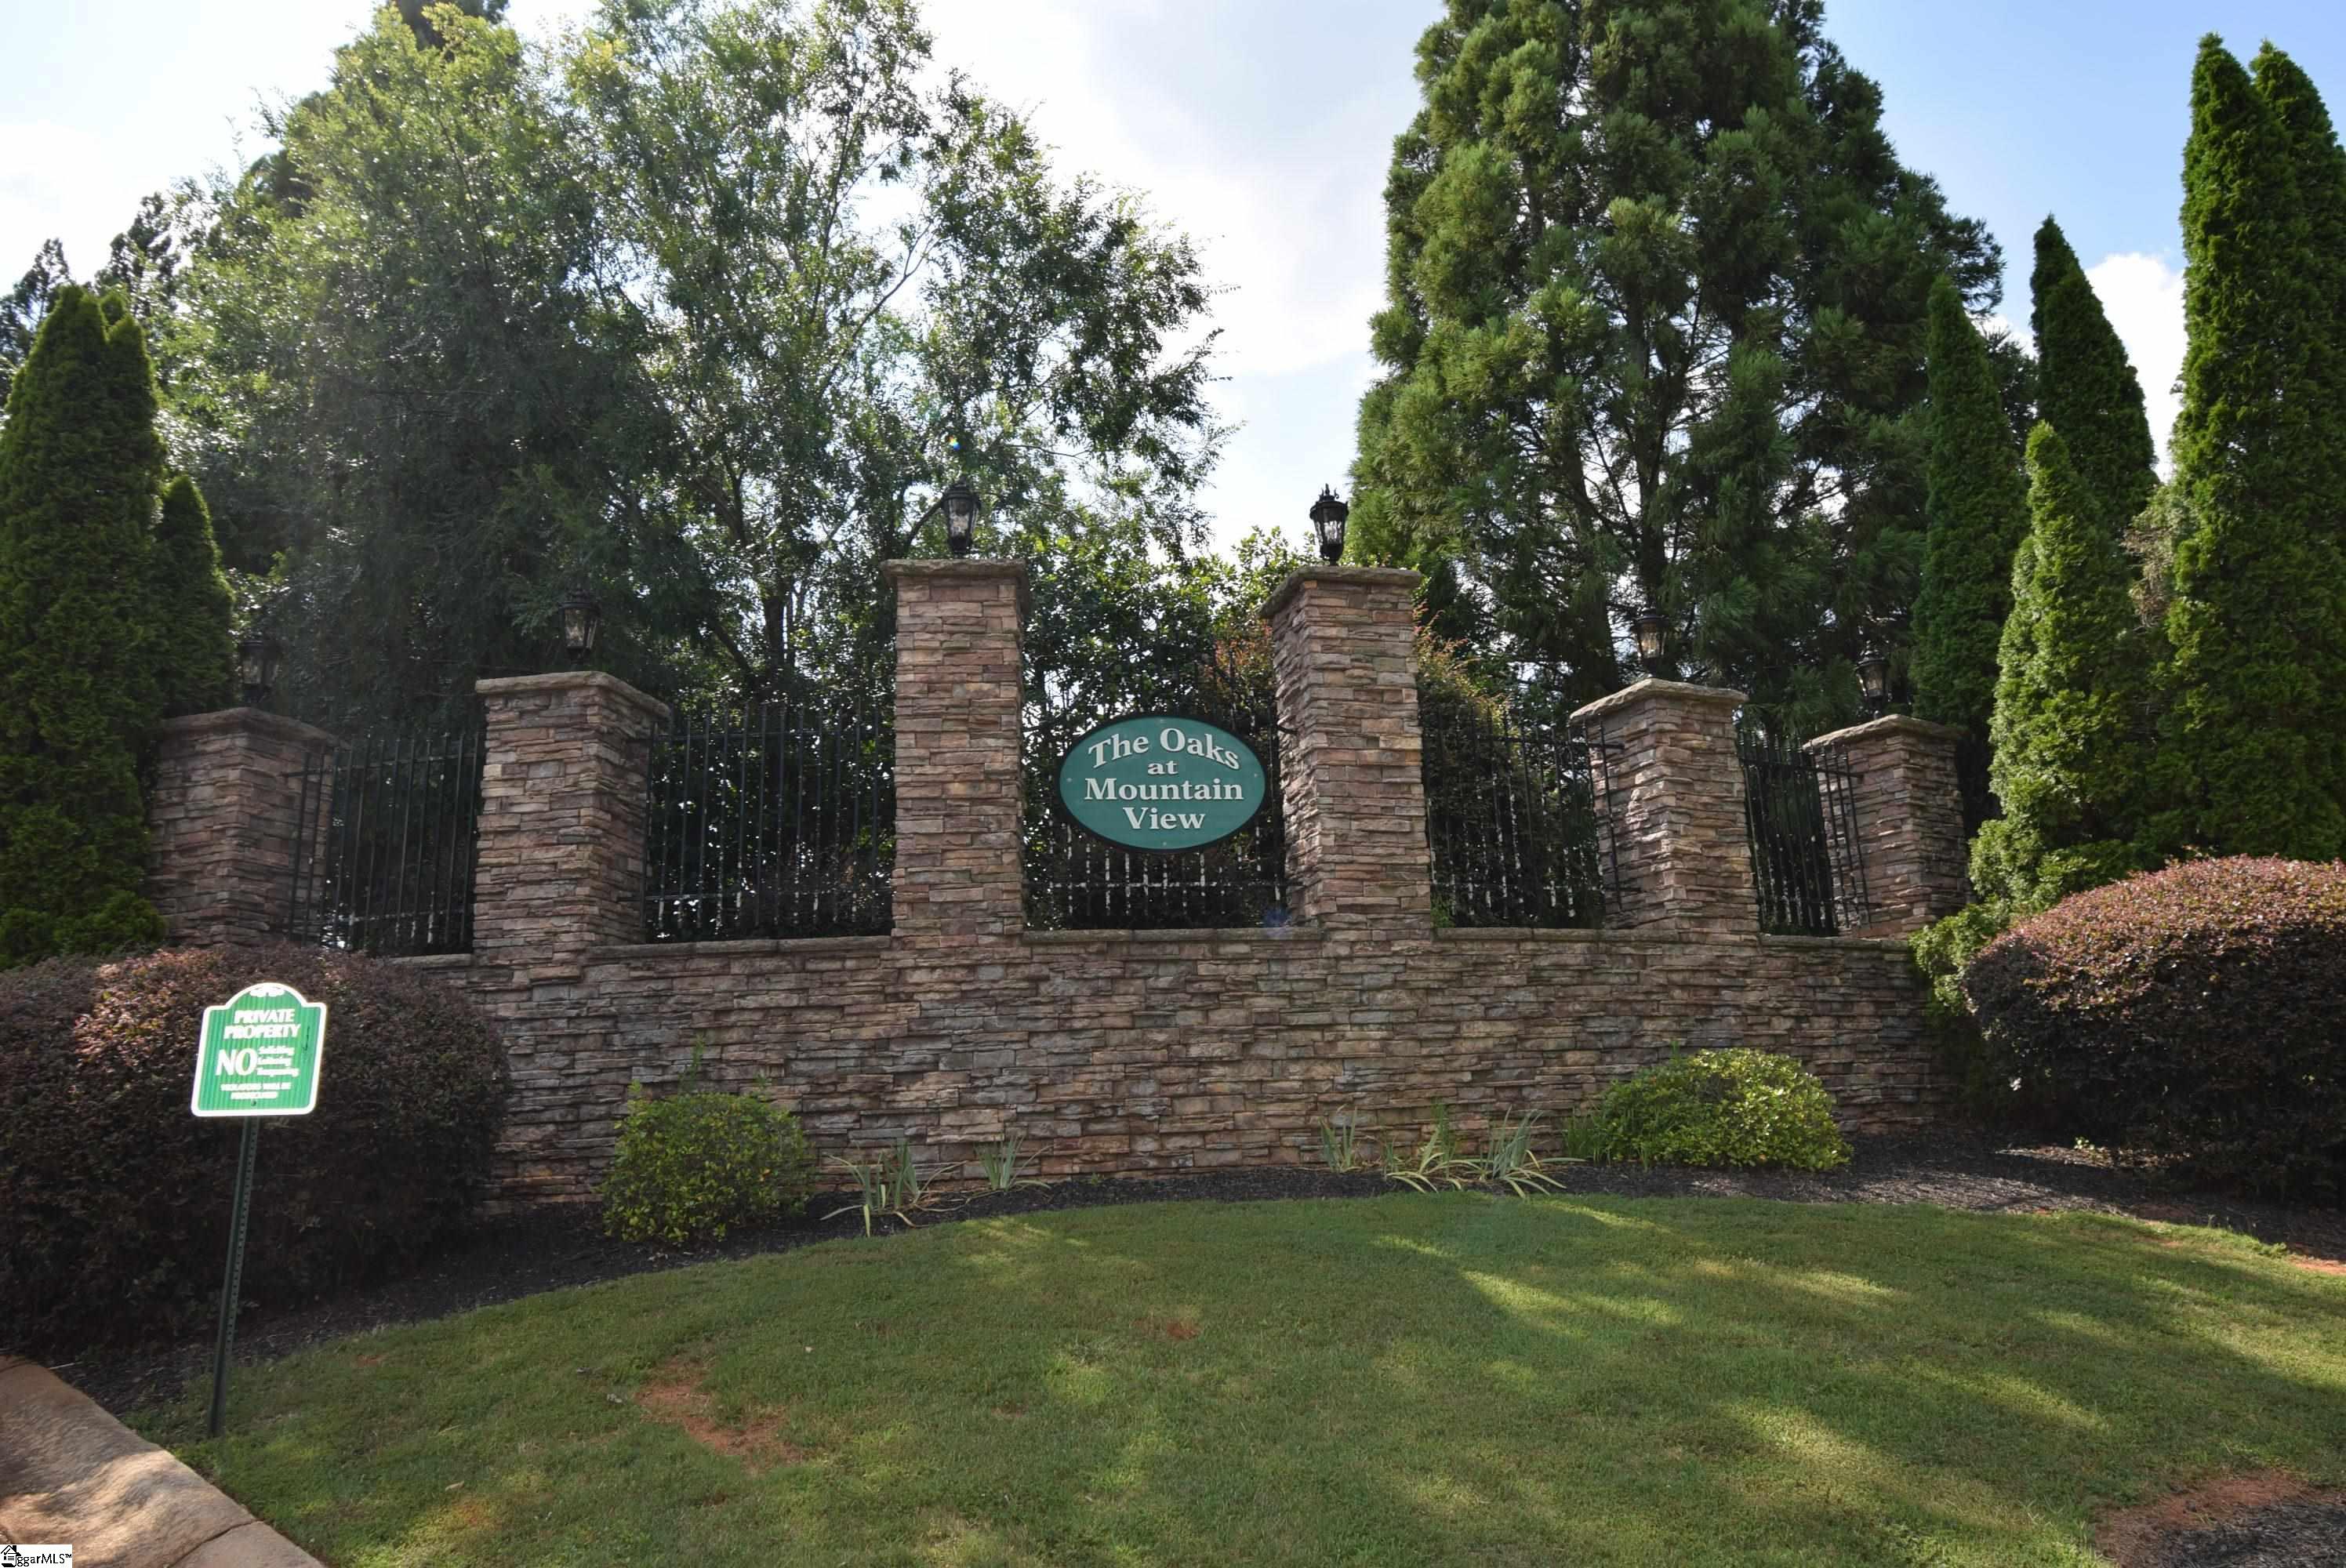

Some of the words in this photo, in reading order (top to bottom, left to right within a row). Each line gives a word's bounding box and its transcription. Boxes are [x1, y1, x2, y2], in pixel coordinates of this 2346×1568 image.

[1088, 733, 1149, 768] The
[1160, 728, 1240, 770] Oaks
[1147, 760, 1179, 775] at
[1084, 778, 1244, 800] Mountain
[1123, 807, 1206, 829] View
[234, 1008, 295, 1024] PRIVATE
[223, 1024, 301, 1040] PROPERTY
[216, 1048, 258, 1076] NO
